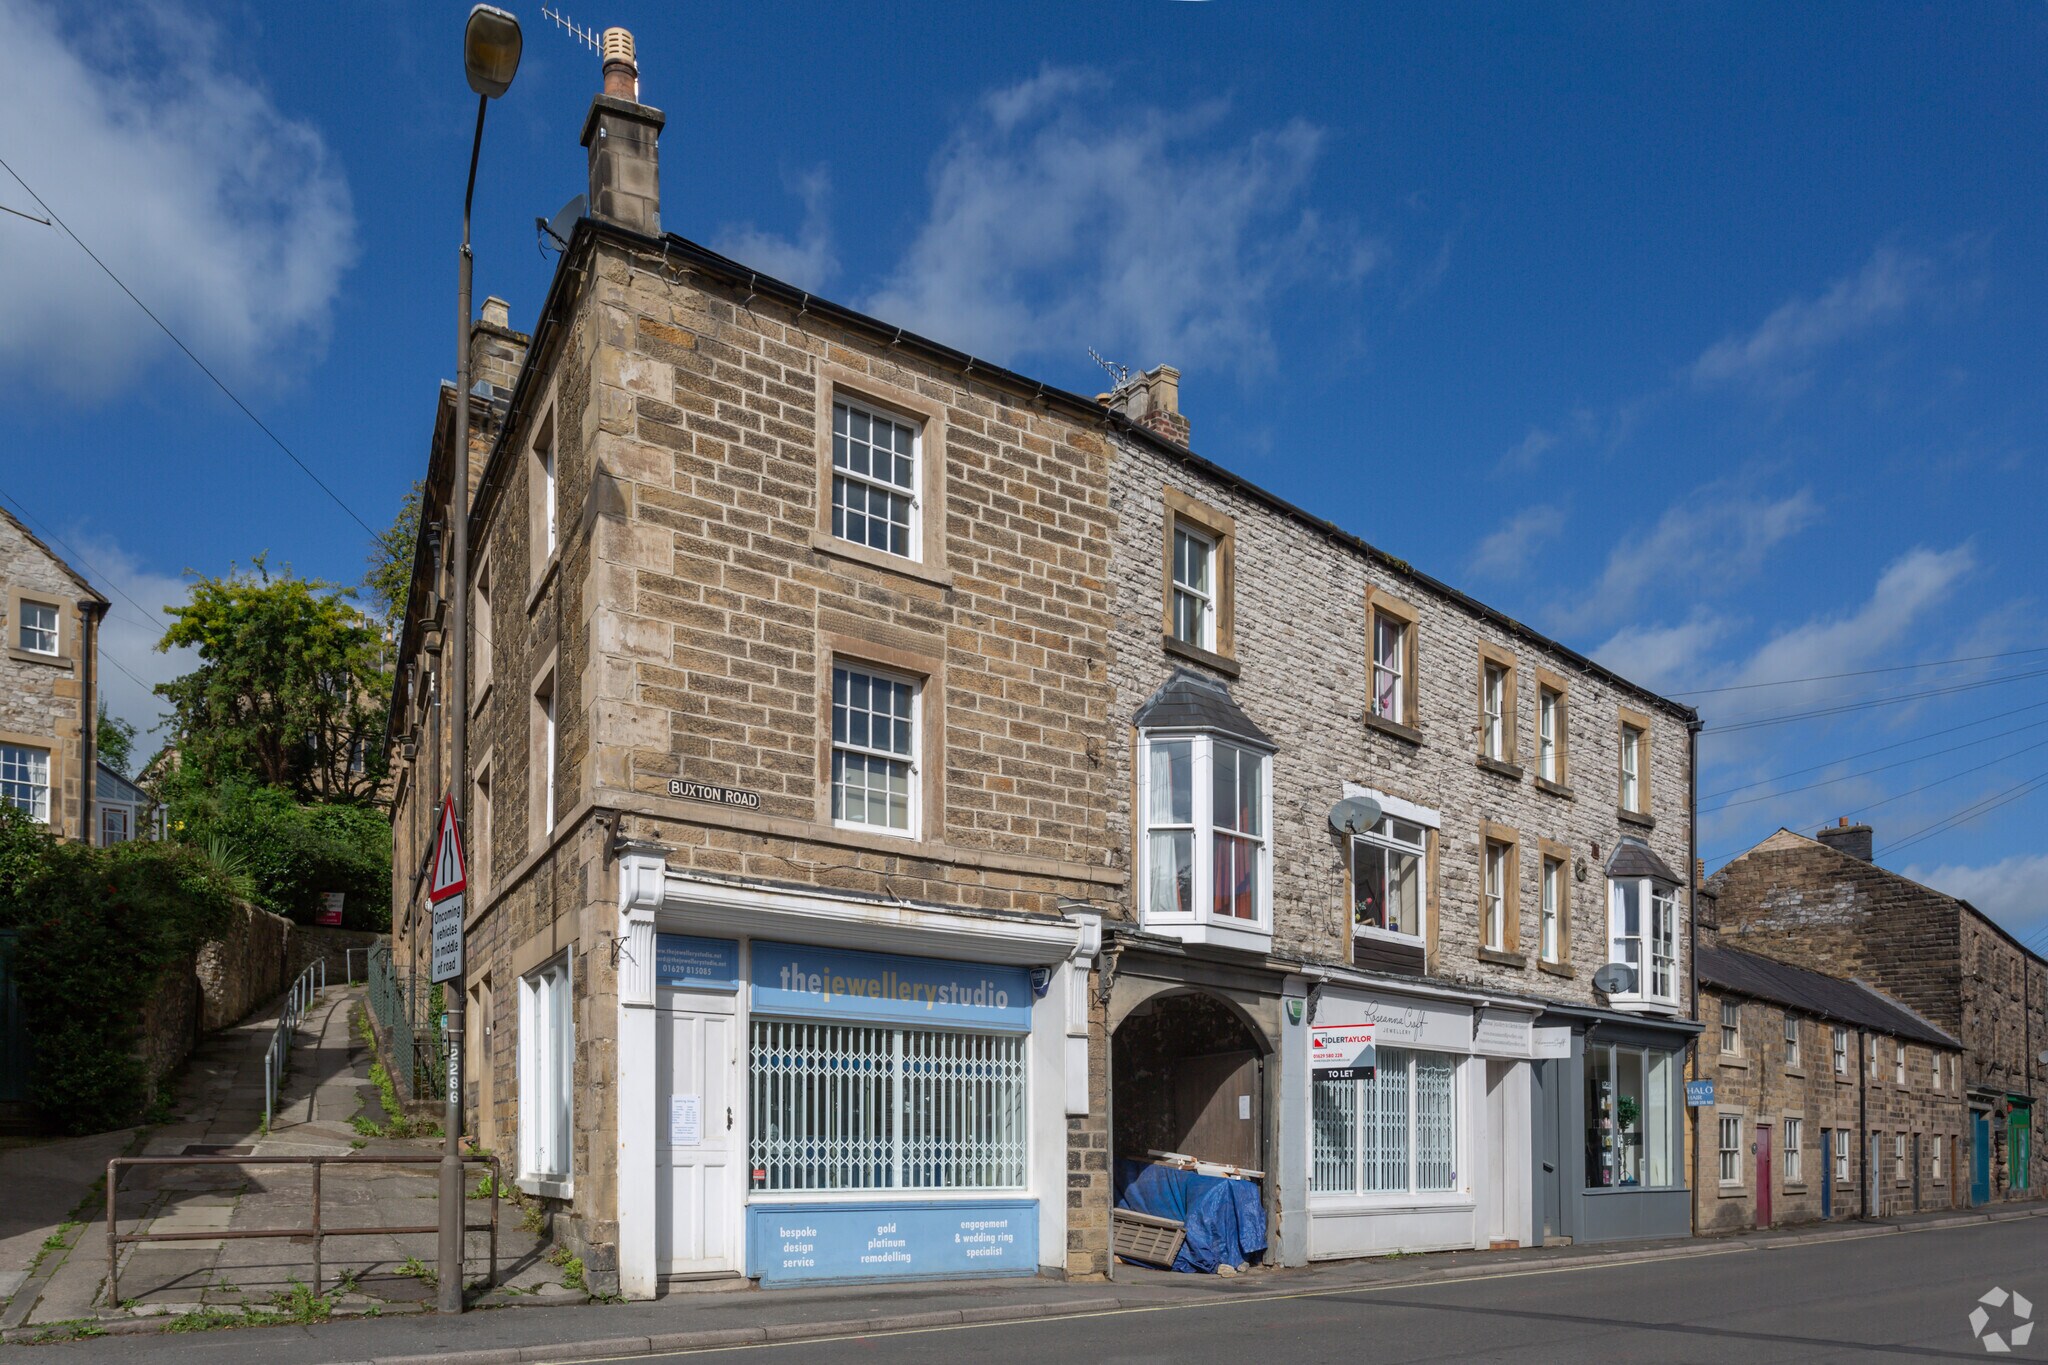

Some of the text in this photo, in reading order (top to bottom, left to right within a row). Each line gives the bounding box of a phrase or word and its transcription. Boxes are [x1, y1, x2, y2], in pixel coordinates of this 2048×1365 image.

[671, 781, 757, 807] BUXTON ROAD
[435, 905, 460, 924] Oncoming
[437, 924, 458, 940] vehicles
[435, 940, 459, 958] in middle
[437, 957, 456, 975] of road
[662, 965, 712, 976] 01629 815085
[780, 962, 1009, 1011] thejewellerystudio
[1364, 1000, 1429, 1042] Roseanna Croft
[1321, 1035, 1372, 1044] FIDLERTAYLOR
[1328, 1069, 1354, 1078] TO LET
[1686, 1086, 1714, 1095] HALO
[877, 1222, 896, 1236] gold
[960, 1219, 1008, 1231] engagement
[780, 1226, 817, 1240] bespoke
[954, 1232, 1014, 1244] & wedding ring
[783, 1242, 814, 1254] design
[867, 1238, 906, 1251] platinum
[860, 1252, 912, 1264] remodelling
[966, 1246, 1003, 1259] specialist
[783, 1257, 815, 1268] service
